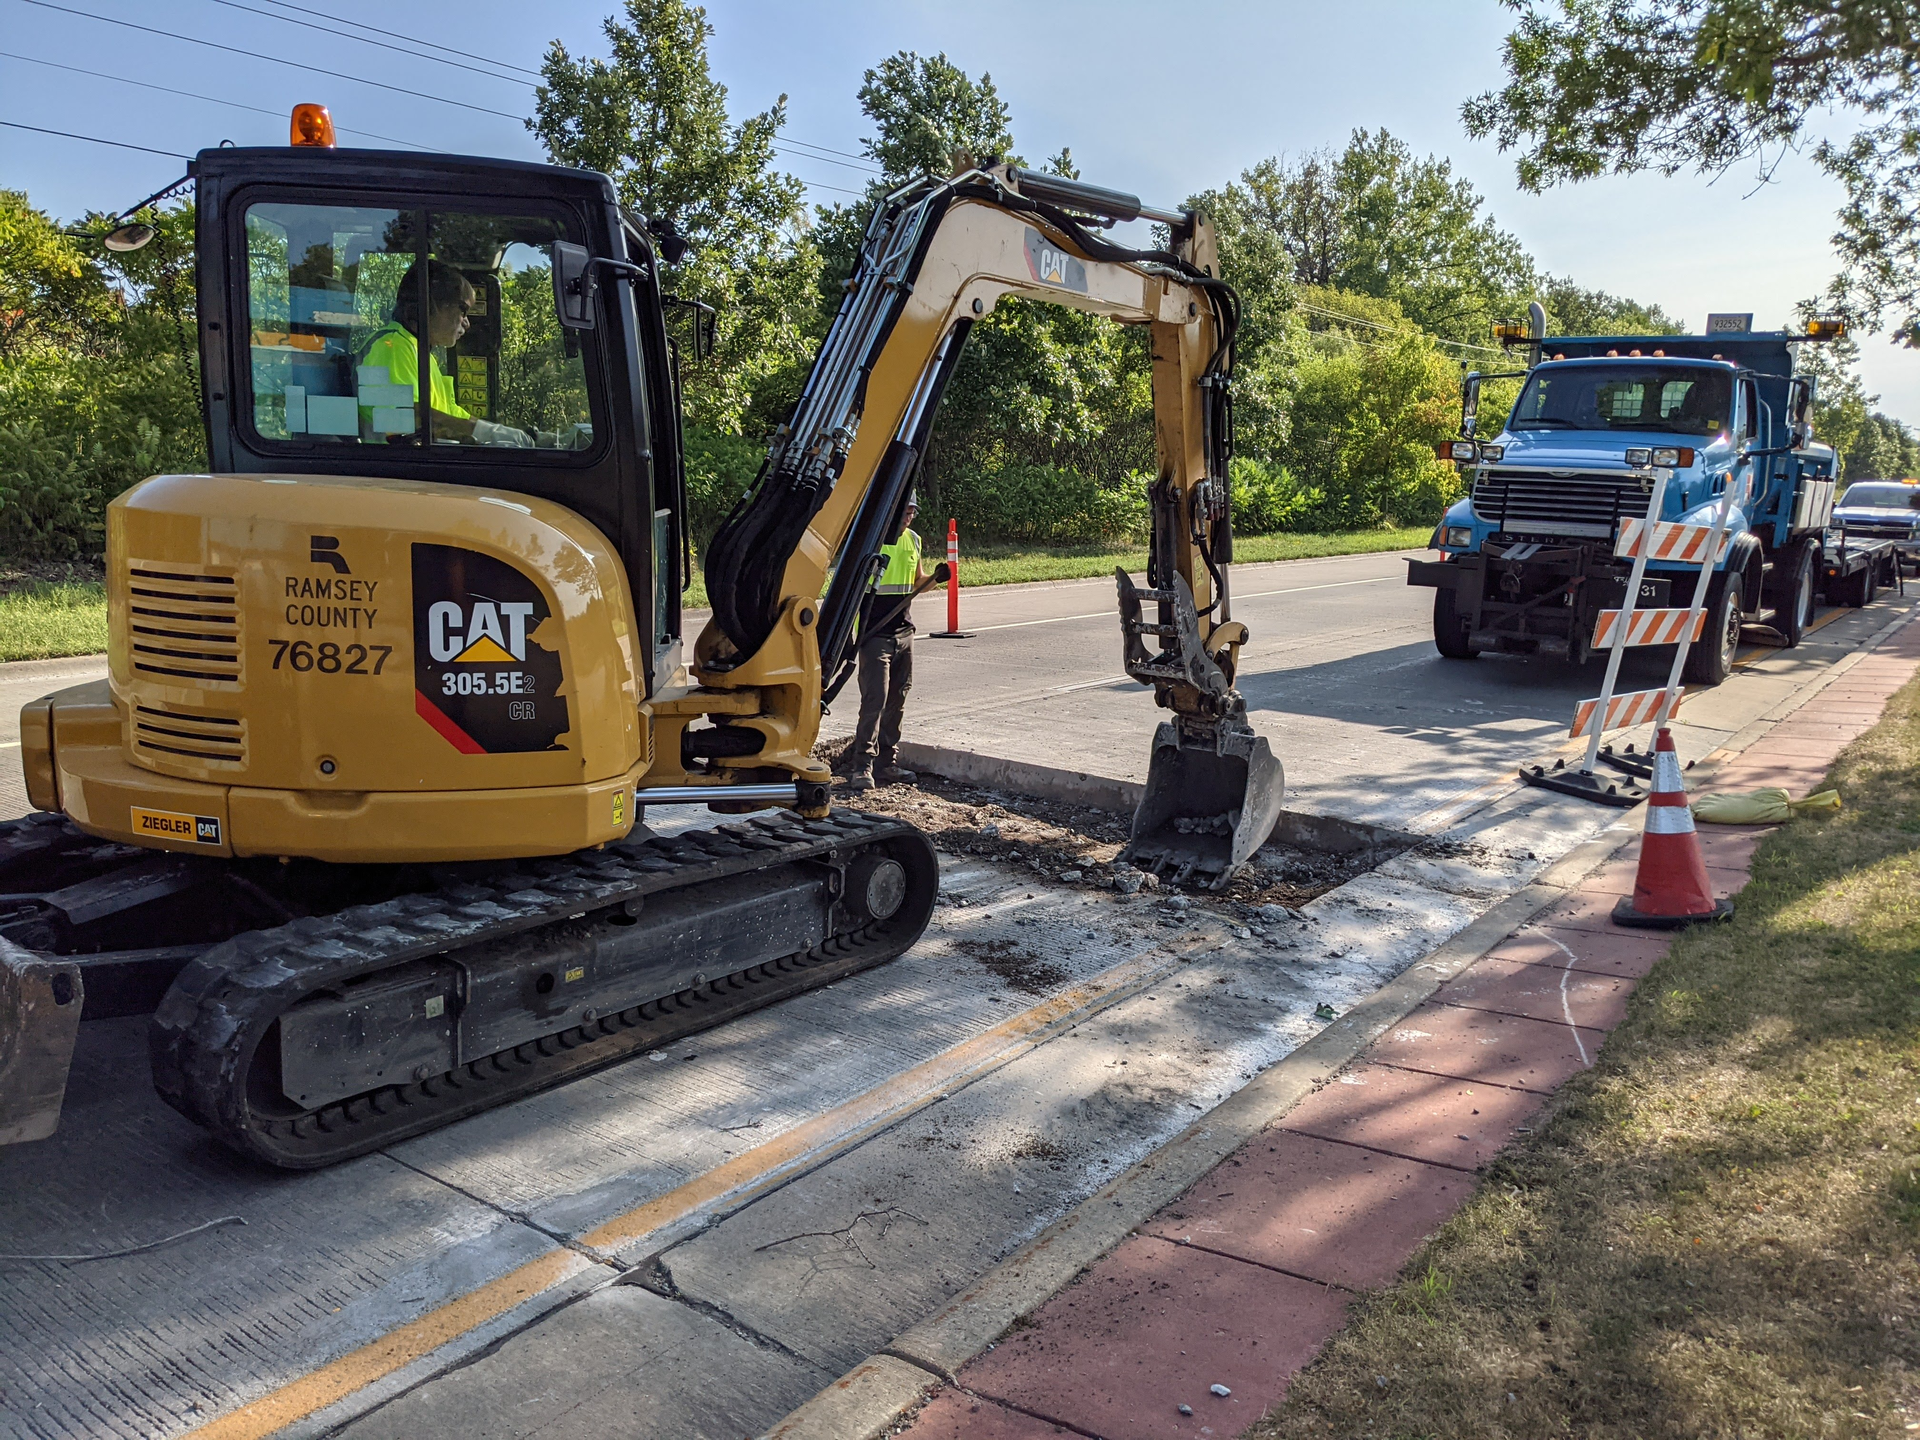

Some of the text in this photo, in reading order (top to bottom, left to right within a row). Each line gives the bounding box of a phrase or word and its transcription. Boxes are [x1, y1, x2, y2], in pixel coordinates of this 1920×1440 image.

[1040, 249, 1069, 284] CAT
[285, 576, 378, 602] RAMSEY
[285, 604, 378, 629] COUNTY
[428, 601, 534, 662] CAT
[268, 639, 393, 676] 76827
[442, 672, 536, 696] 305.5E2
[509, 701, 536, 721] CR
[142, 815, 217, 838] ZIEGLER CAT
